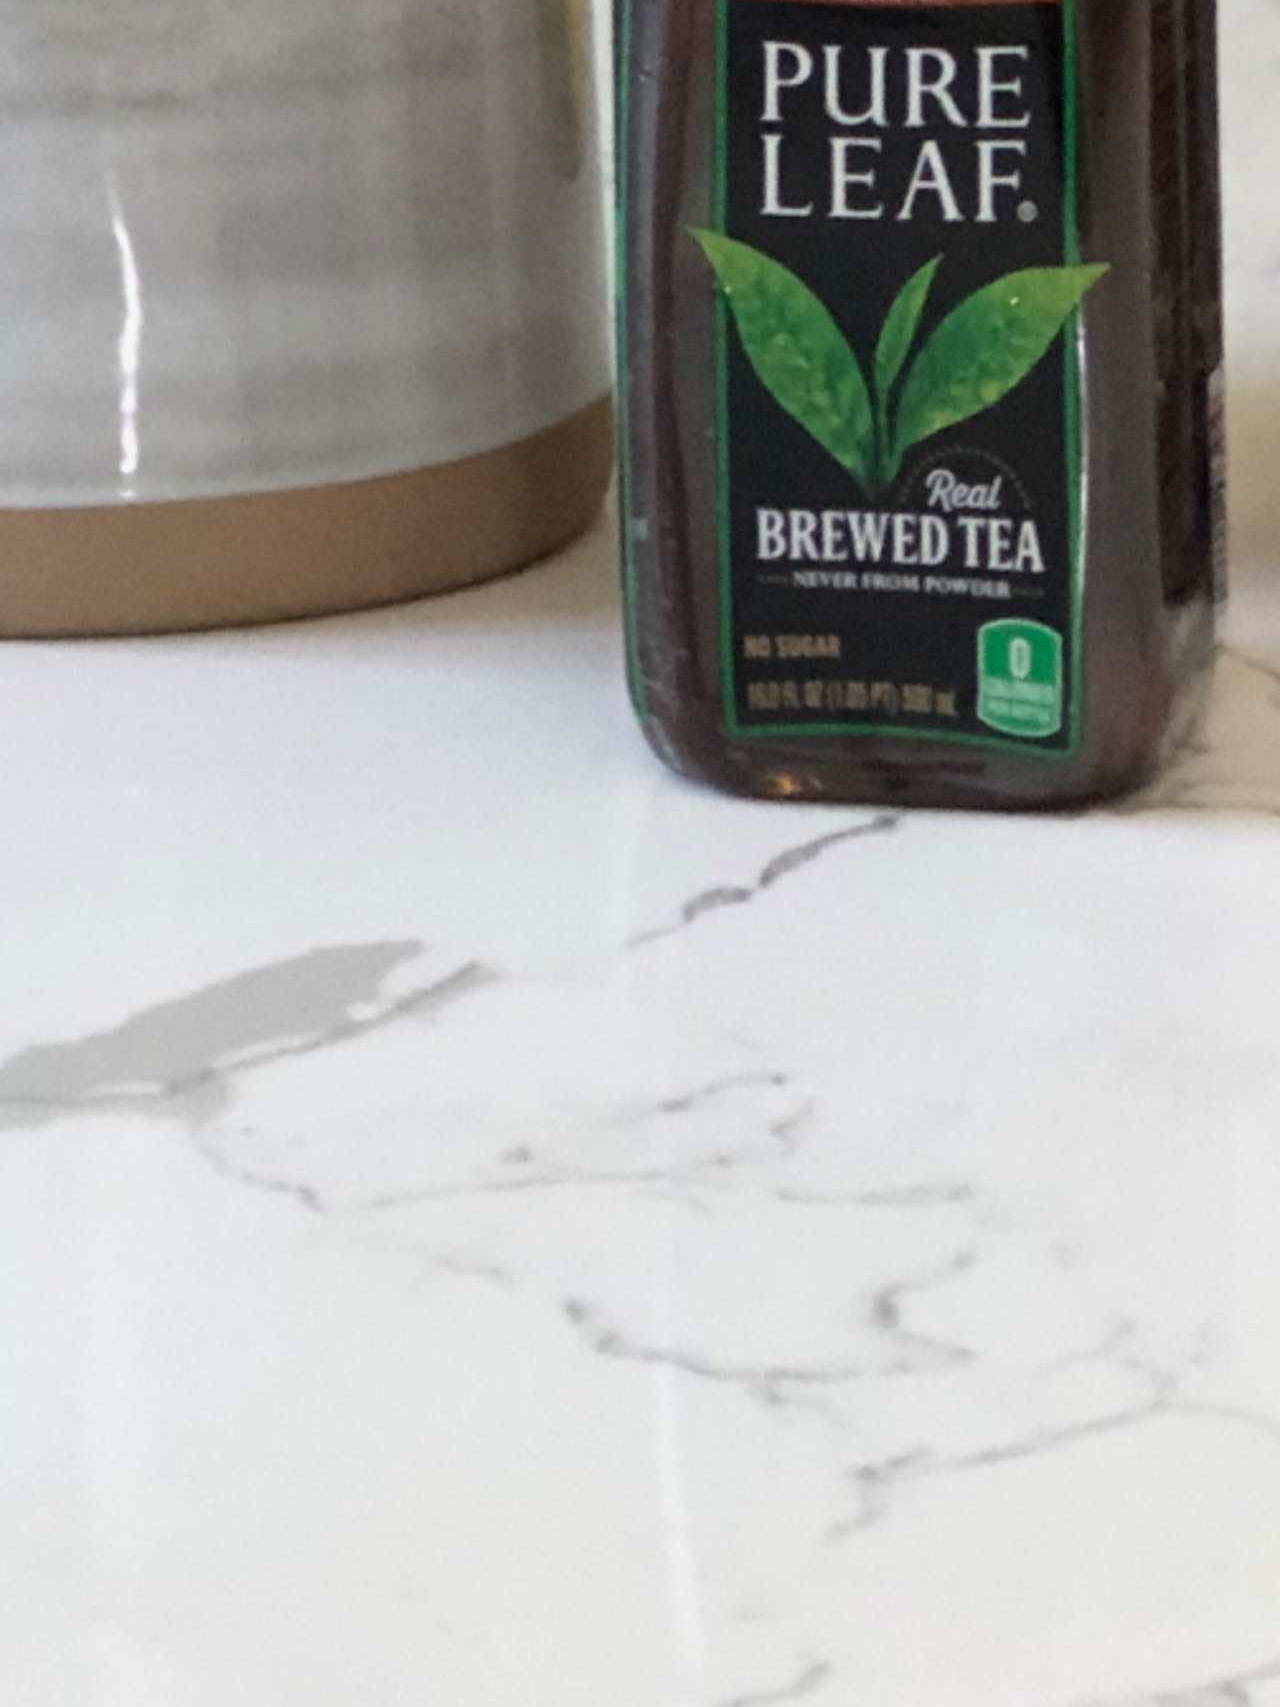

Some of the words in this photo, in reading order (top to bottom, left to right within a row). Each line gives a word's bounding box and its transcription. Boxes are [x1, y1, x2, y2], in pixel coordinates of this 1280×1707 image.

[760, 40, 1032, 128] PURE
[759, 133, 1026, 223] LEAF
[926, 469, 1001, 511] Real
[756, 508, 950, 565] BREWED
[957, 516, 1045, 573] TEA
[793, 570, 858, 588] NEVER
[861, 573, 920, 592] FROM
[925, 577, 1012, 598] POWDER
[1009, 637, 1032, 679] 0
